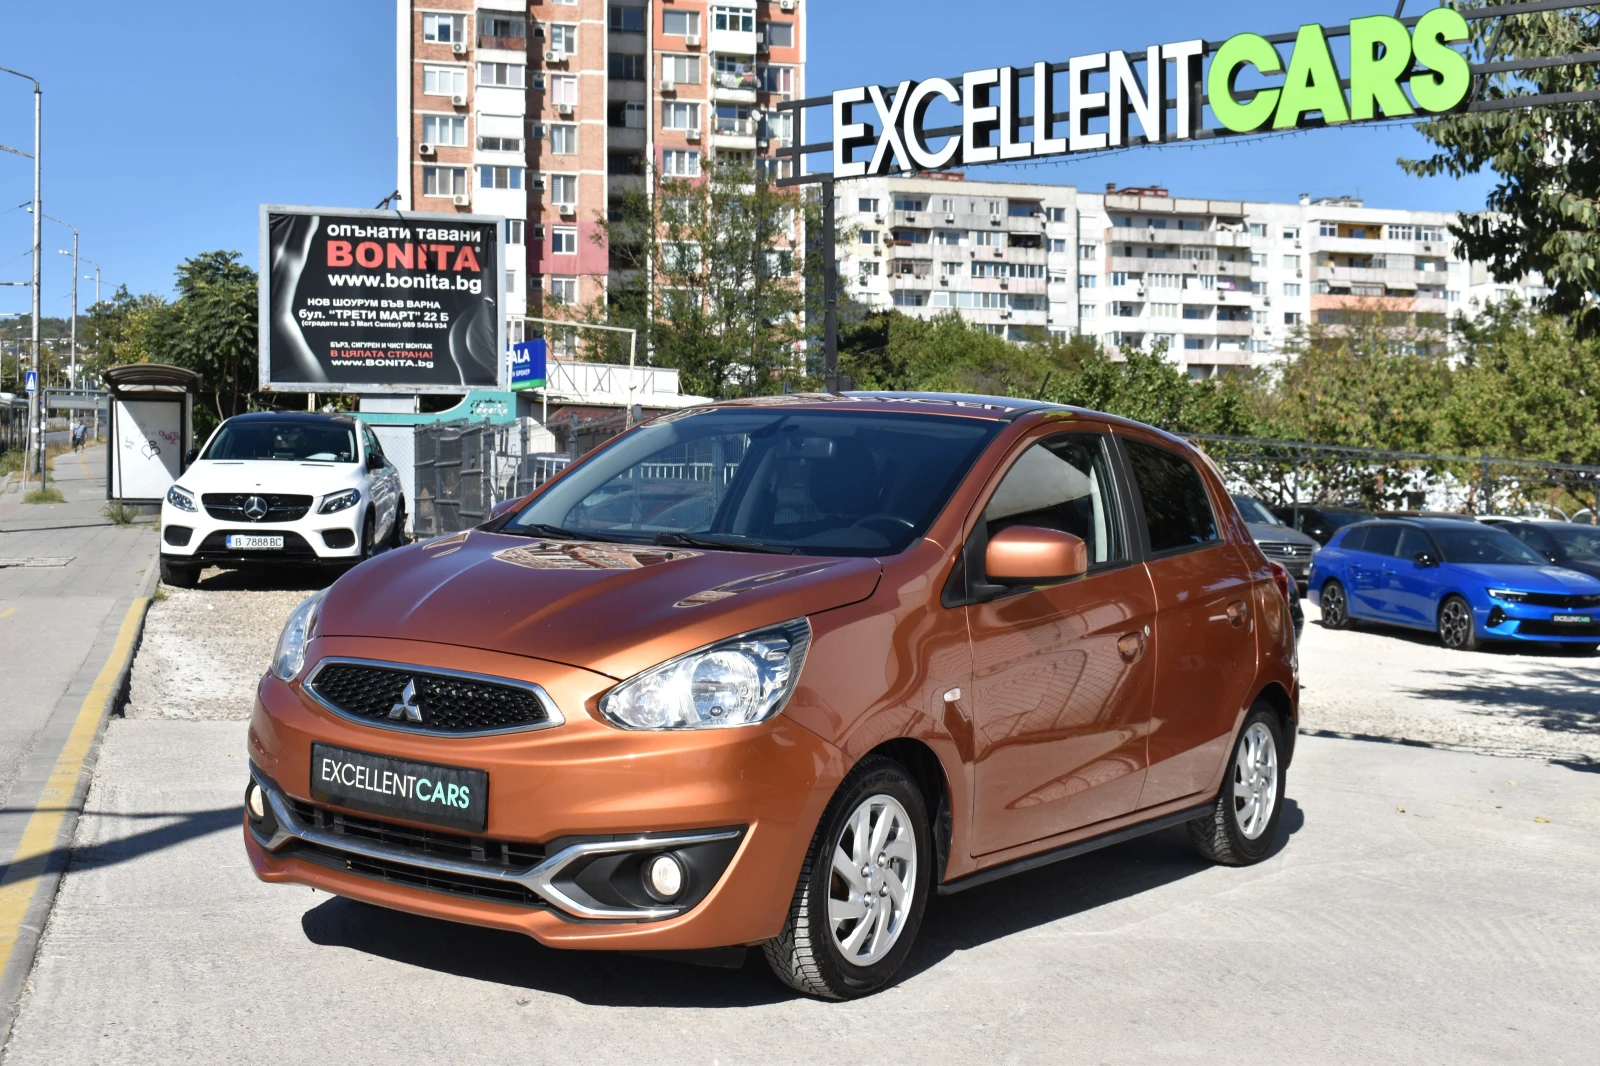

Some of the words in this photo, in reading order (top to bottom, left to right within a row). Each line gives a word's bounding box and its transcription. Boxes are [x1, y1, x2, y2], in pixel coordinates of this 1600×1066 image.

[327, 224, 411, 239] опънати
[416, 228, 481, 242] тавани
[328, 273, 482, 294] www.bonita.bg
[307, 298, 330, 306] НОВ
[332, 298, 378, 308] ШОУРУМ
[380, 299, 404, 308] ВЪВ
[406, 300, 441, 309] ВАРНА
[299, 309, 326, 320] бул.
[424, 312, 438, 321] 22
[440, 312, 449, 321] Б
[341, 350, 385, 358] ЦЯЛАТА
[331, 359, 434, 368] www.BONITA.bg
[246, 538, 268, 546] 7888
